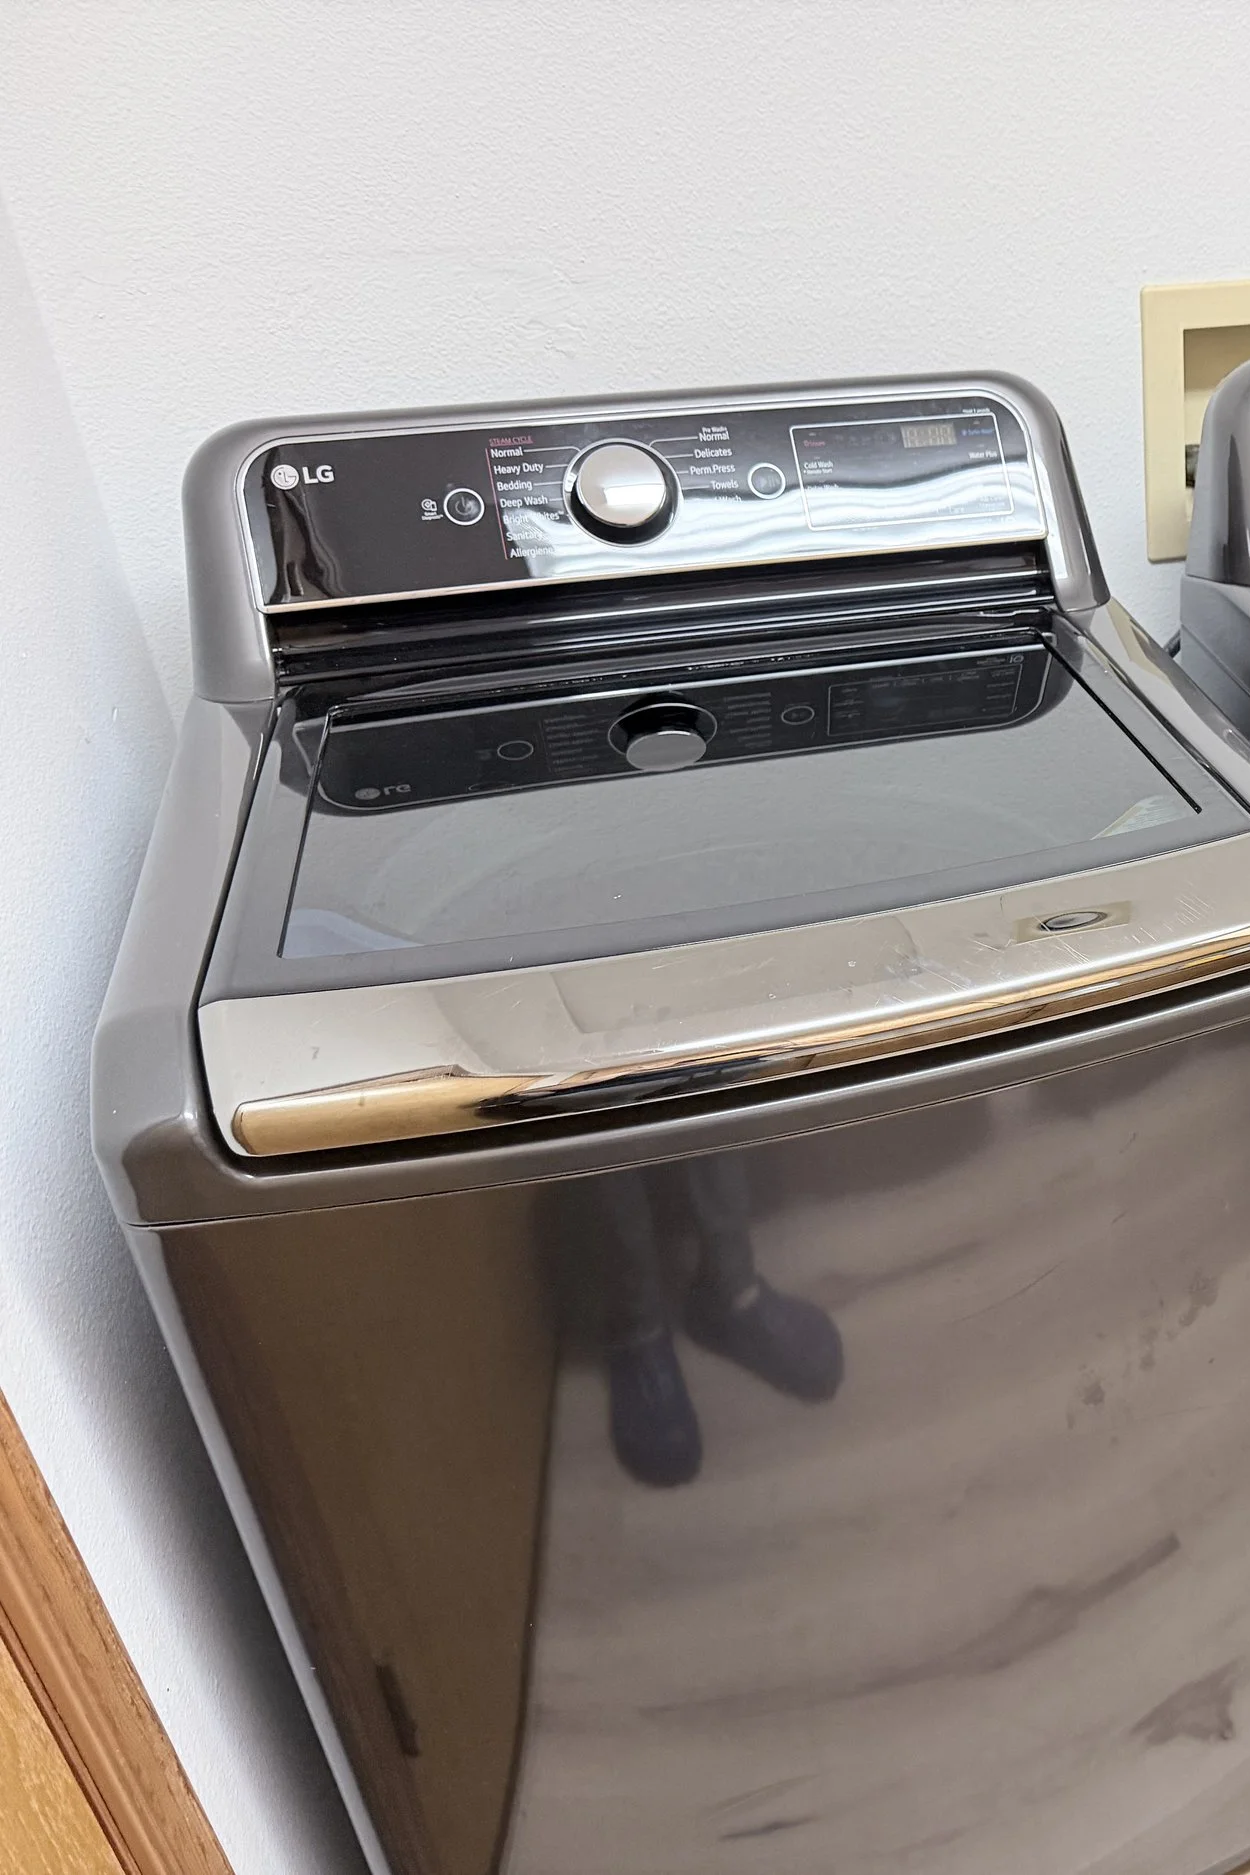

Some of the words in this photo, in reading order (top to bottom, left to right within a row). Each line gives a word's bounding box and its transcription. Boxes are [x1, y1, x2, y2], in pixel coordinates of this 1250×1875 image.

[489, 437, 512, 447] STEAM
[513, 435, 534, 445] CYCLE
[699, 431, 730, 441] Normal
[490, 446, 523, 458] Normal
[694, 448, 732, 458] Delicates
[493, 465, 521, 475] Heavy
[522, 462, 544, 474] Duty
[690, 464, 735, 475] Perm.Press
[804, 461, 818, 469] Cold
[818, 460, 833, 468] Wash
[302, 464, 335, 484] LG
[496, 480, 533, 491] Bedding
[710, 480, 739, 490] Towels
[500, 498, 523, 508] Deep
[523, 495, 549, 506] Wash
[503, 514, 529, 525] Bright
